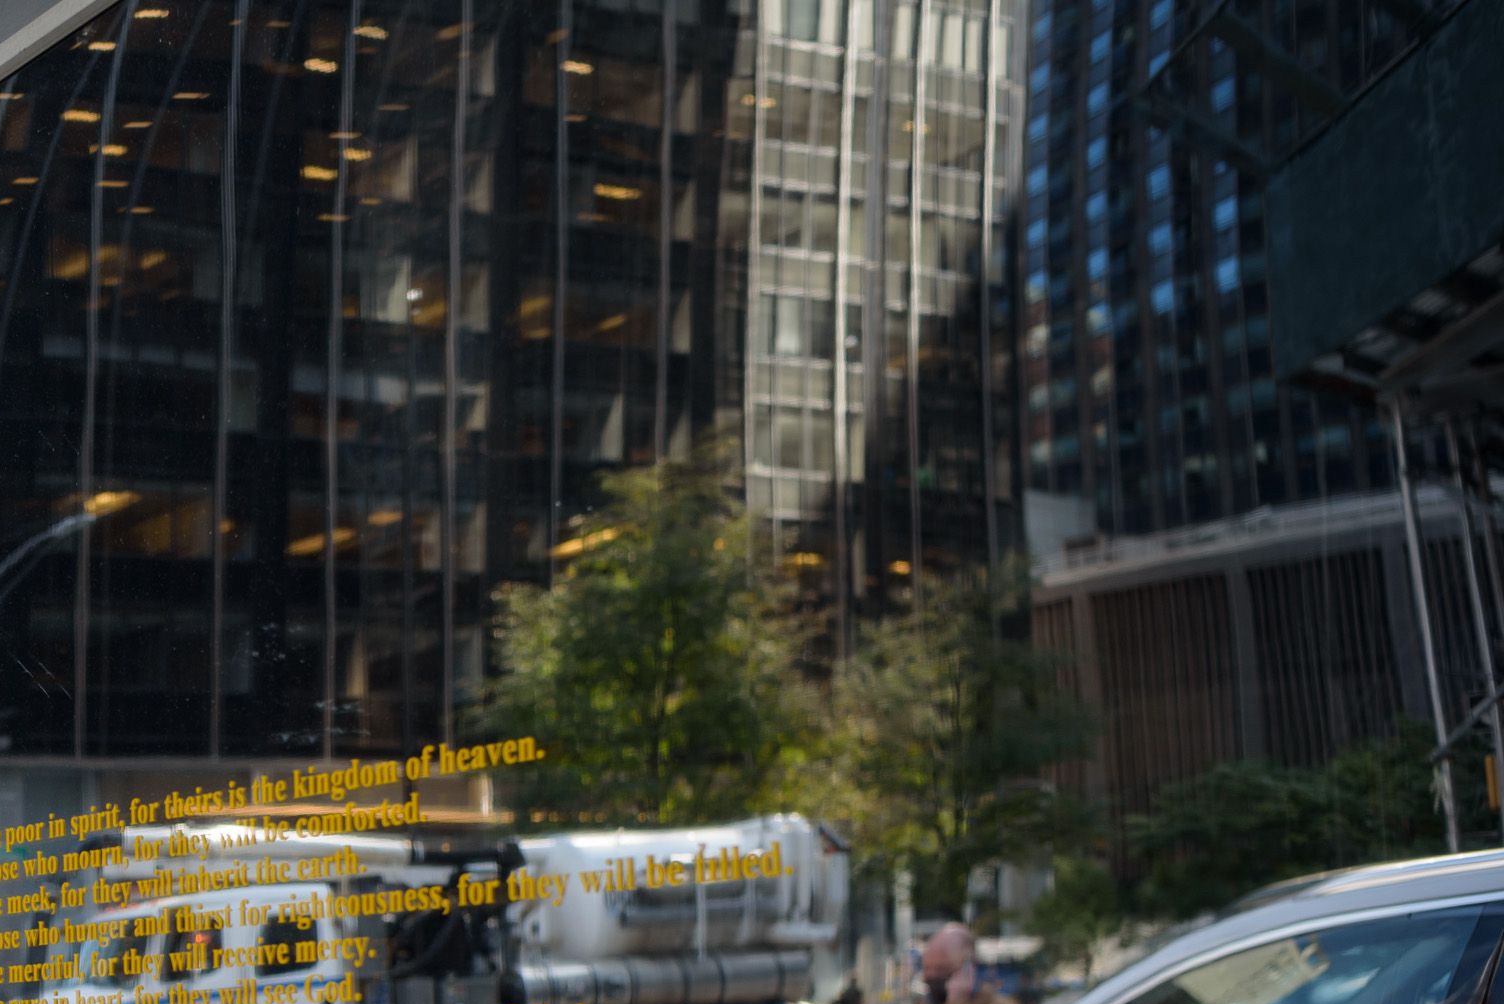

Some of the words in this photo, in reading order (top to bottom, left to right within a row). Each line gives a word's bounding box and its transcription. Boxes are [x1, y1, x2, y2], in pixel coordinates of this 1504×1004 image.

[5, 822, 45, 852] poor
[48, 813, 65, 838] in
[70, 803, 125, 841] spirit,
[130, 798, 160, 824] for
[165, 787, 223, 819] theirs
[229, 781, 246, 809] is
[252, 776, 288, 804] the
[293, 759, 400, 799] kingdom
[406, 745, 435, 780] of
[438, 736, 545, 776] heaven.
[24, 852, 56, 877] who
[63, 846, 129, 872] mourn,
[134, 835, 163, 861] for
[169, 830, 210, 860] they
[263, 816, 289, 842] be
[296, 792, 428, 838] comforted.
[7, 886, 57, 914] meek,
[61, 882, 88, 908] for
[93, 878, 132, 908] they
[137, 869, 173, 898] will
[178, 859, 249, 894] inherit
[256, 856, 290, 885] the
[297, 846, 367, 880] earth.
[25, 920, 59, 946] who
[65, 917, 128, 946] hunger
[134, 907, 170, 940] and
[176, 904, 232, 933] thirst
[239, 899, 271, 926] for
[277, 884, 450, 930] righteousness,
[457, 876, 500, 906] for
[506, 865, 569, 905] they
[580, 857, 636, 893] will
[647, 855, 684, 888] be
[696, 841, 794, 884] filled.
[9, 955, 85, 983] merciful,
[91, 952, 118, 976] for
[123, 948, 164, 981] they
[170, 943, 208, 972] will
[213, 937, 289, 968] receive
[296, 936, 377, 968] mercy.
[263, 982, 297, 1004] see
[304, 972, 362, 1002] God.
